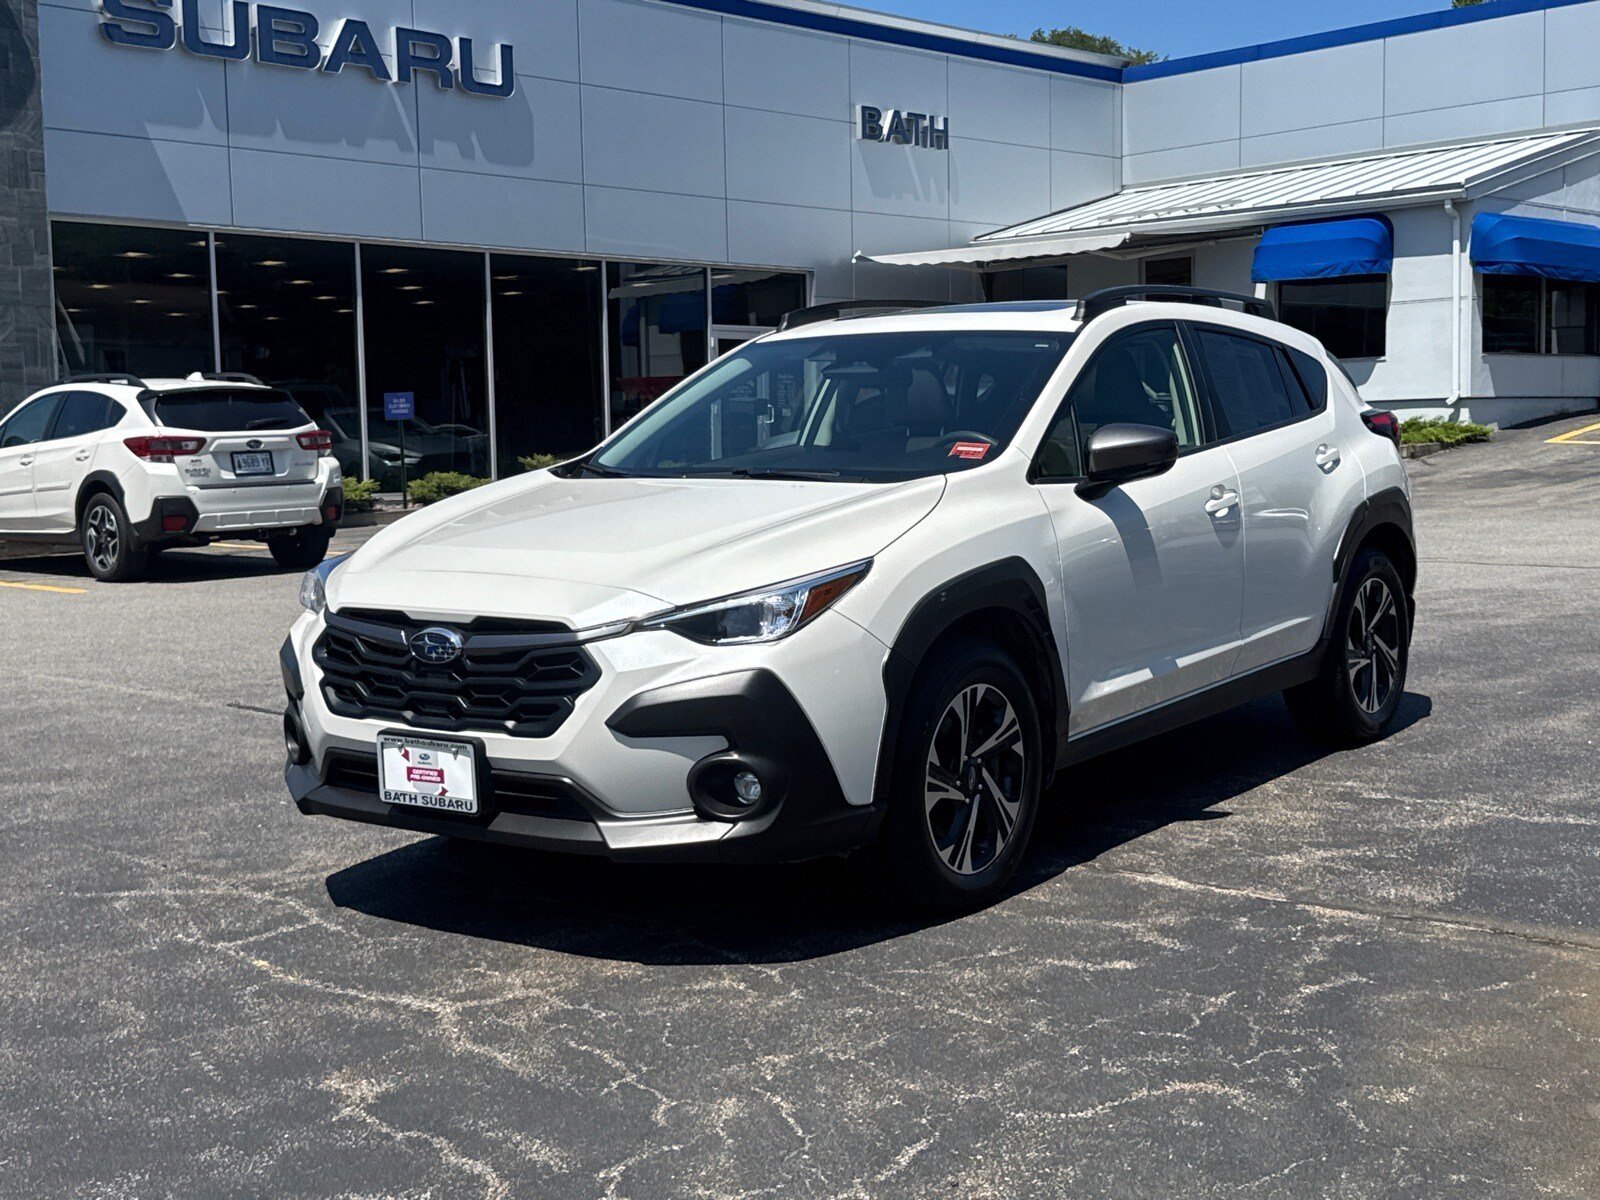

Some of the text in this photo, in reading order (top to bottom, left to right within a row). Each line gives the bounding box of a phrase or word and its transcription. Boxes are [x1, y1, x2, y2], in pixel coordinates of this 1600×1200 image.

[98, 0, 516, 98] SUBARU
[856, 104, 949, 150] BATH
[384, 790, 474, 812] BATH SUBARU
